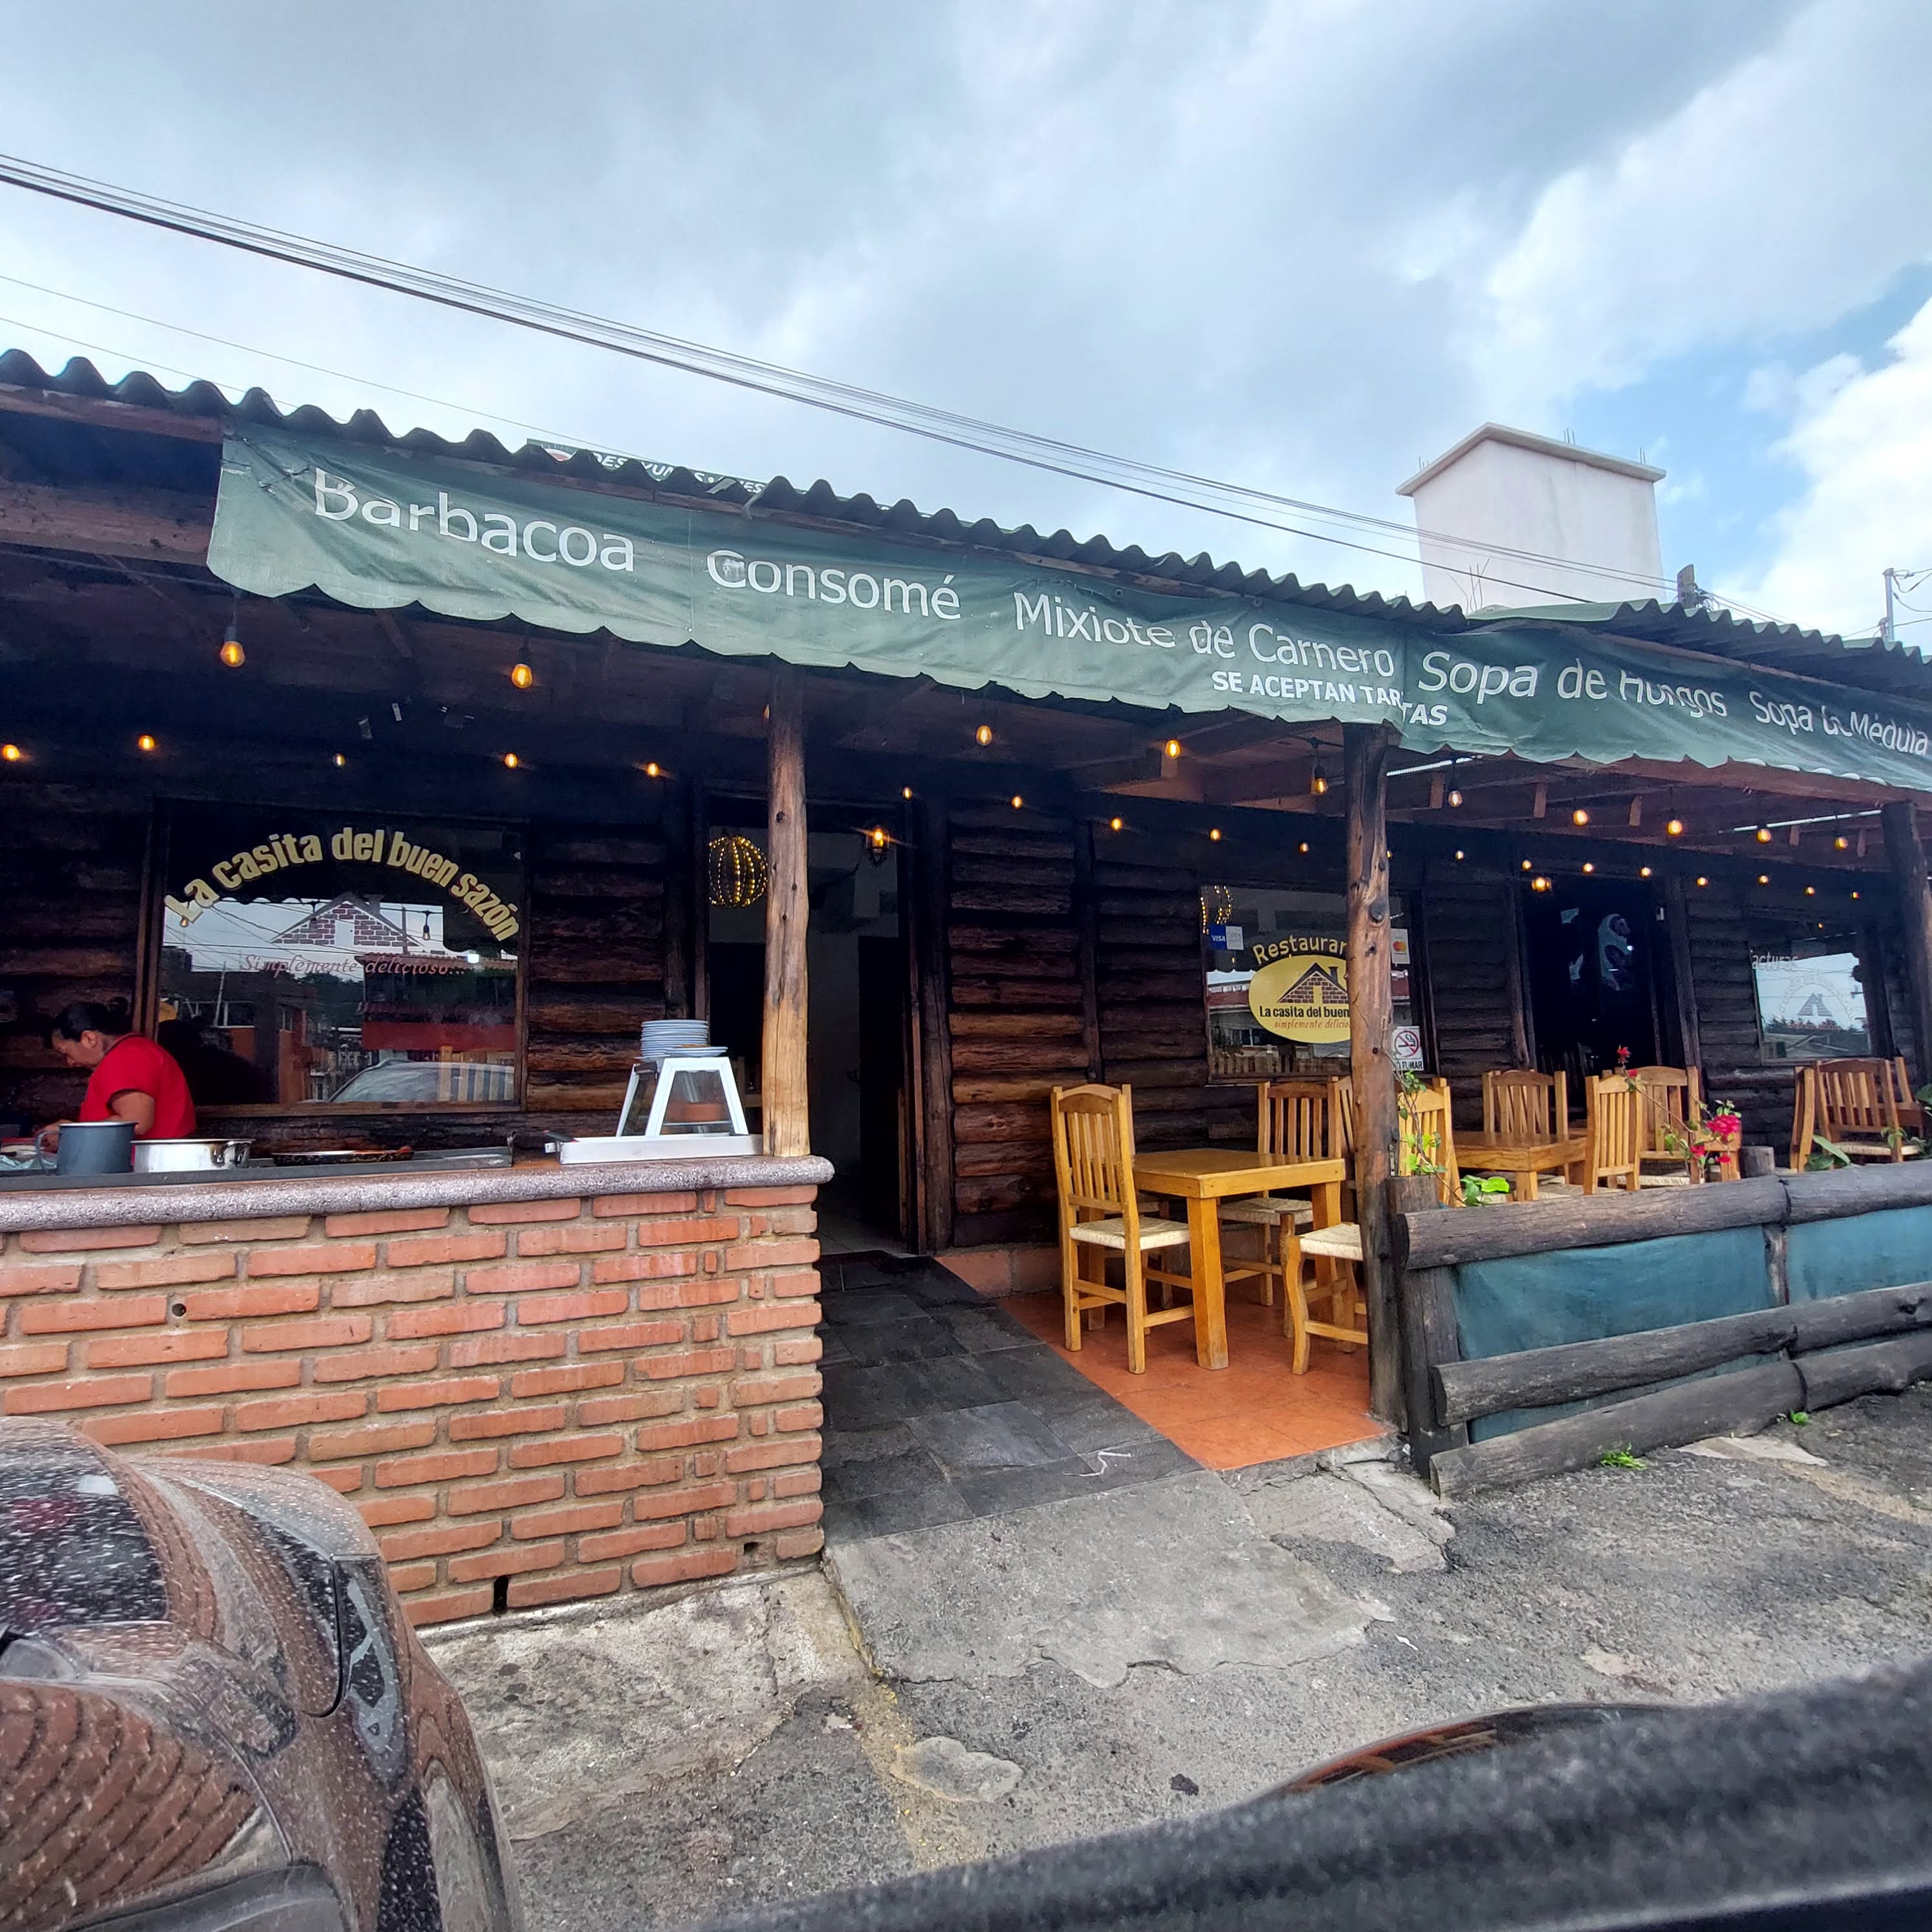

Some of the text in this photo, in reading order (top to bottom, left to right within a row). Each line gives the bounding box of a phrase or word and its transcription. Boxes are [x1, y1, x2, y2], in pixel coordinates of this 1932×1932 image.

[314, 468, 635, 572] Barbacoa
[706, 550, 961, 620] Consomé
[1013, 591, 1394, 677] Mixiote de Carnero
[1211, 671, 1243, 693] SE
[1249, 675, 1355, 703] ACEPTAN
[1418, 652, 1538, 704] Sopa
[1557, 657, 1607, 699] de
[1749, 691, 1814, 735] Sopa
[164, 827, 520, 941] La casita del buen sazón
[240, 954, 356, 978] Simplemente
[1260, 1005, 1350, 1018] La casita del buen
[1275, 1018, 1349, 1031] simplemente delicio
[1402, 1061, 1423, 1070] FUMAR
